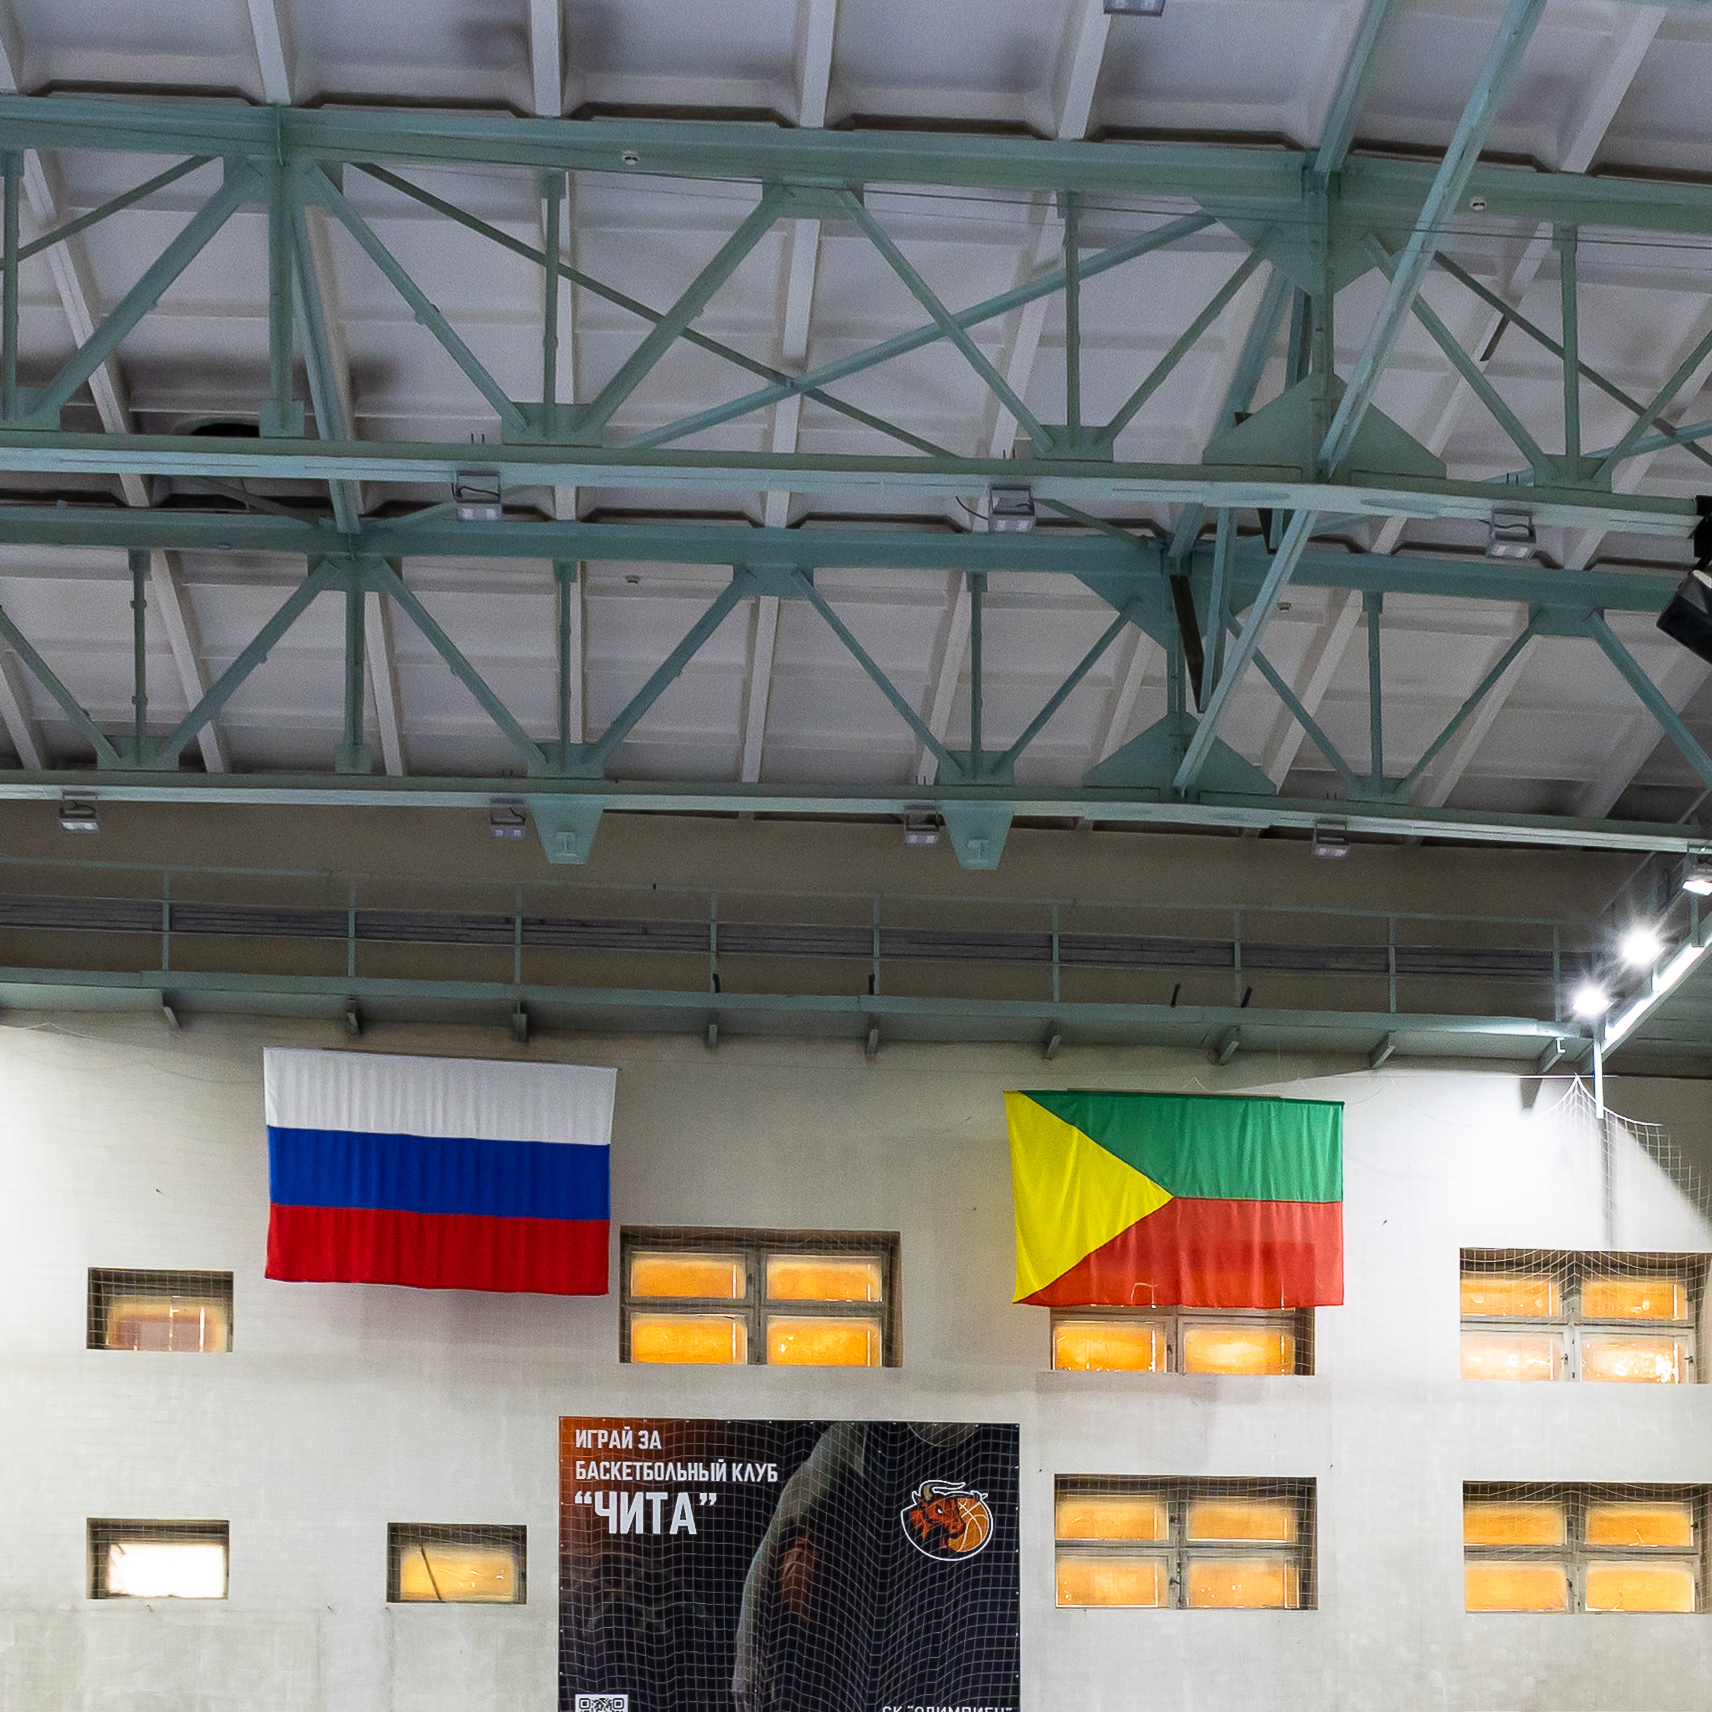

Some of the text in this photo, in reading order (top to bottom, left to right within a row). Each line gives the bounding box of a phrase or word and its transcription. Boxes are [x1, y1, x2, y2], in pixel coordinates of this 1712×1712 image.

[575, 1426, 662, 1450] ИГРАЙ ЗА
[575, 1459, 778, 1483] БАСКЕТБОЛЬНЫЙ КЛУБ
